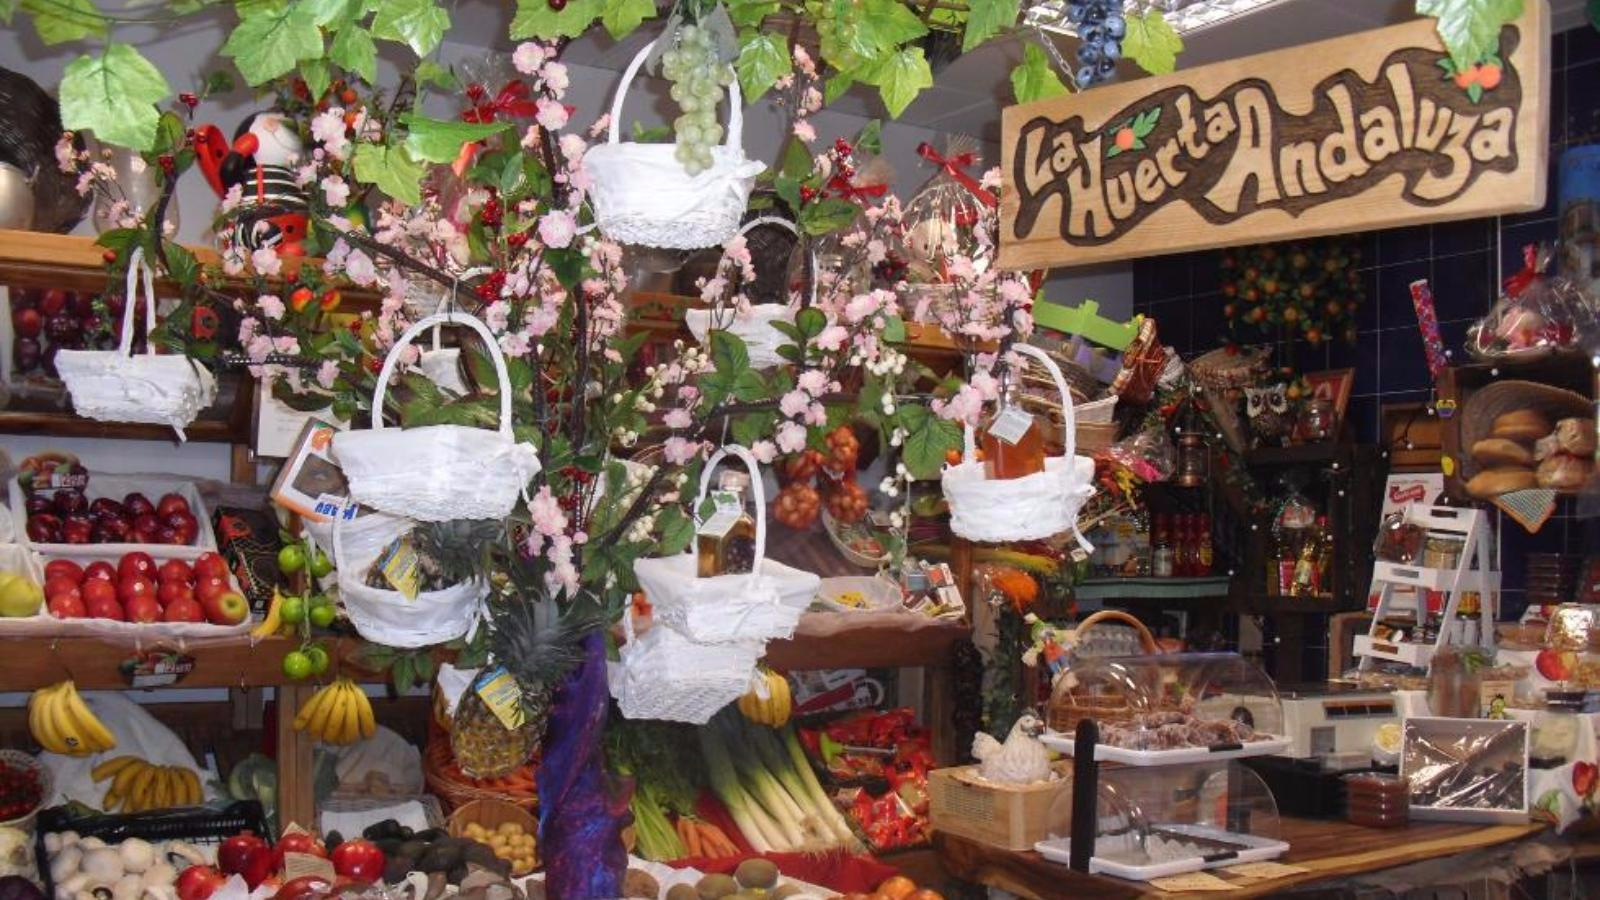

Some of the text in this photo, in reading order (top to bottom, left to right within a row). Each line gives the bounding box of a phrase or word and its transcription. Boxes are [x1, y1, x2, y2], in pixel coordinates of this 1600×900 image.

[1024, 61, 1513, 238] La Huerta Andaluza
